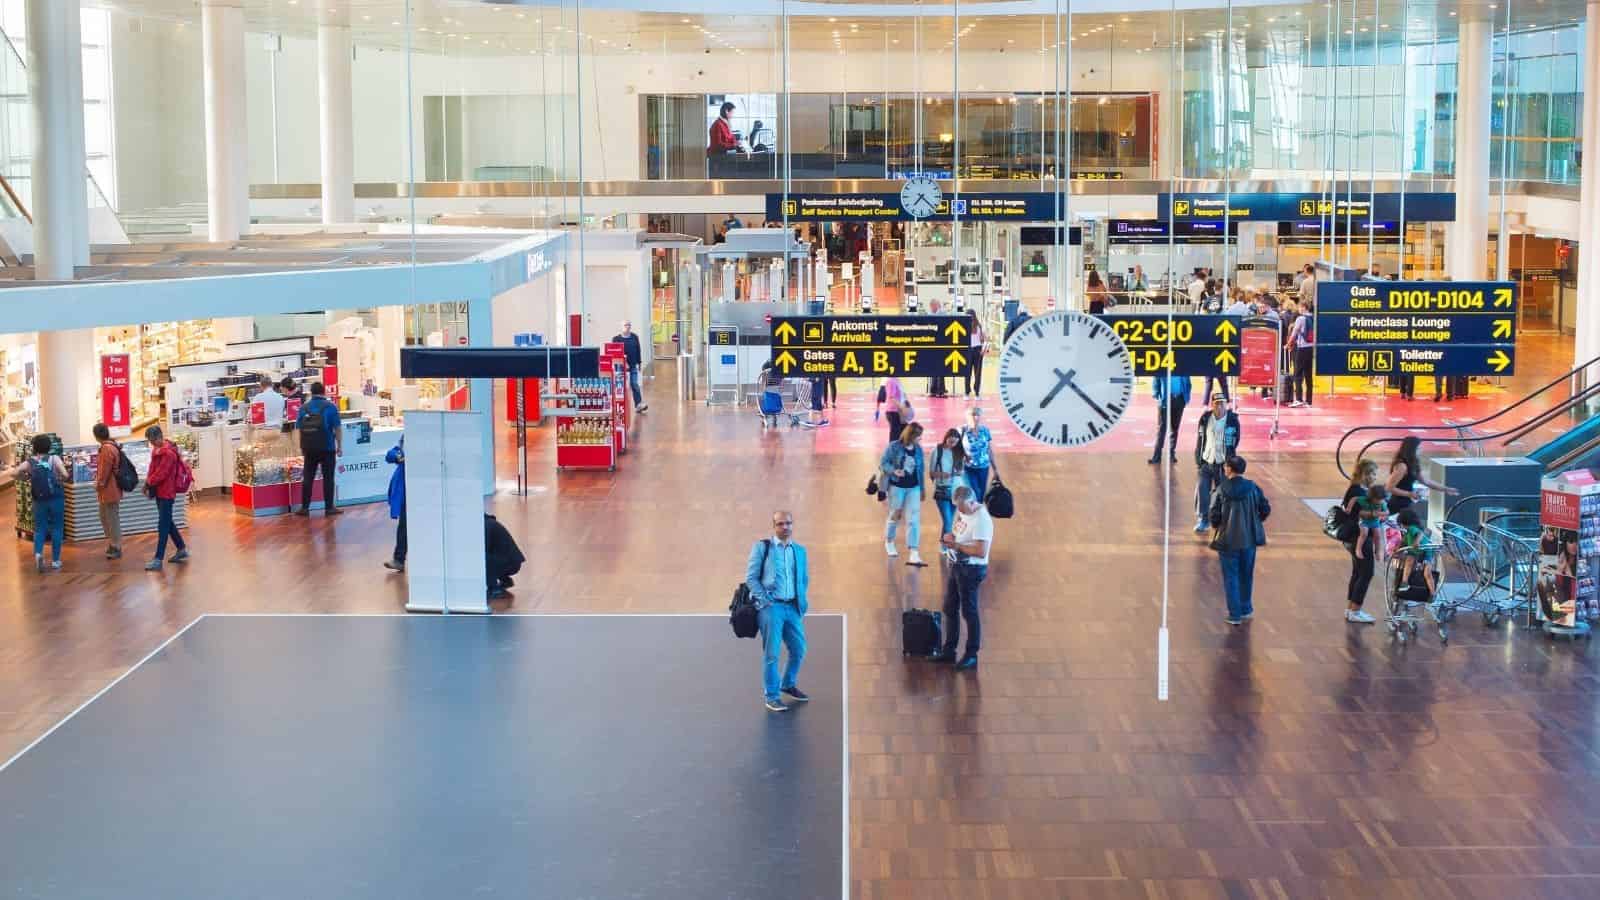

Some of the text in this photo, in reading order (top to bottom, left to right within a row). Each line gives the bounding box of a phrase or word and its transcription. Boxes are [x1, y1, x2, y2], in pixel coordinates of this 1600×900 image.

[1351, 286, 1484, 309] Gate D101-D104
[1351, 298, 1381, 309] Gates
[831, 320, 878, 331] Ankomst
[1350, 317, 1451, 329] Primeclass Lounge
[1113, 320, 1193, 342] C2-C10
[1350, 329, 1451, 341] Primeclass Lounge
[831, 332, 872, 343] Arrivals
[1400, 350, 1443, 360] Toiletter
[803, 350, 917, 374] Gates A, B, F
[803, 362, 835, 373] Gates
[1400, 362, 1435, 373] Toilets
[344, 461, 379, 473] TAX FREE
[1545, 493, 1567, 505] TRAVEL
